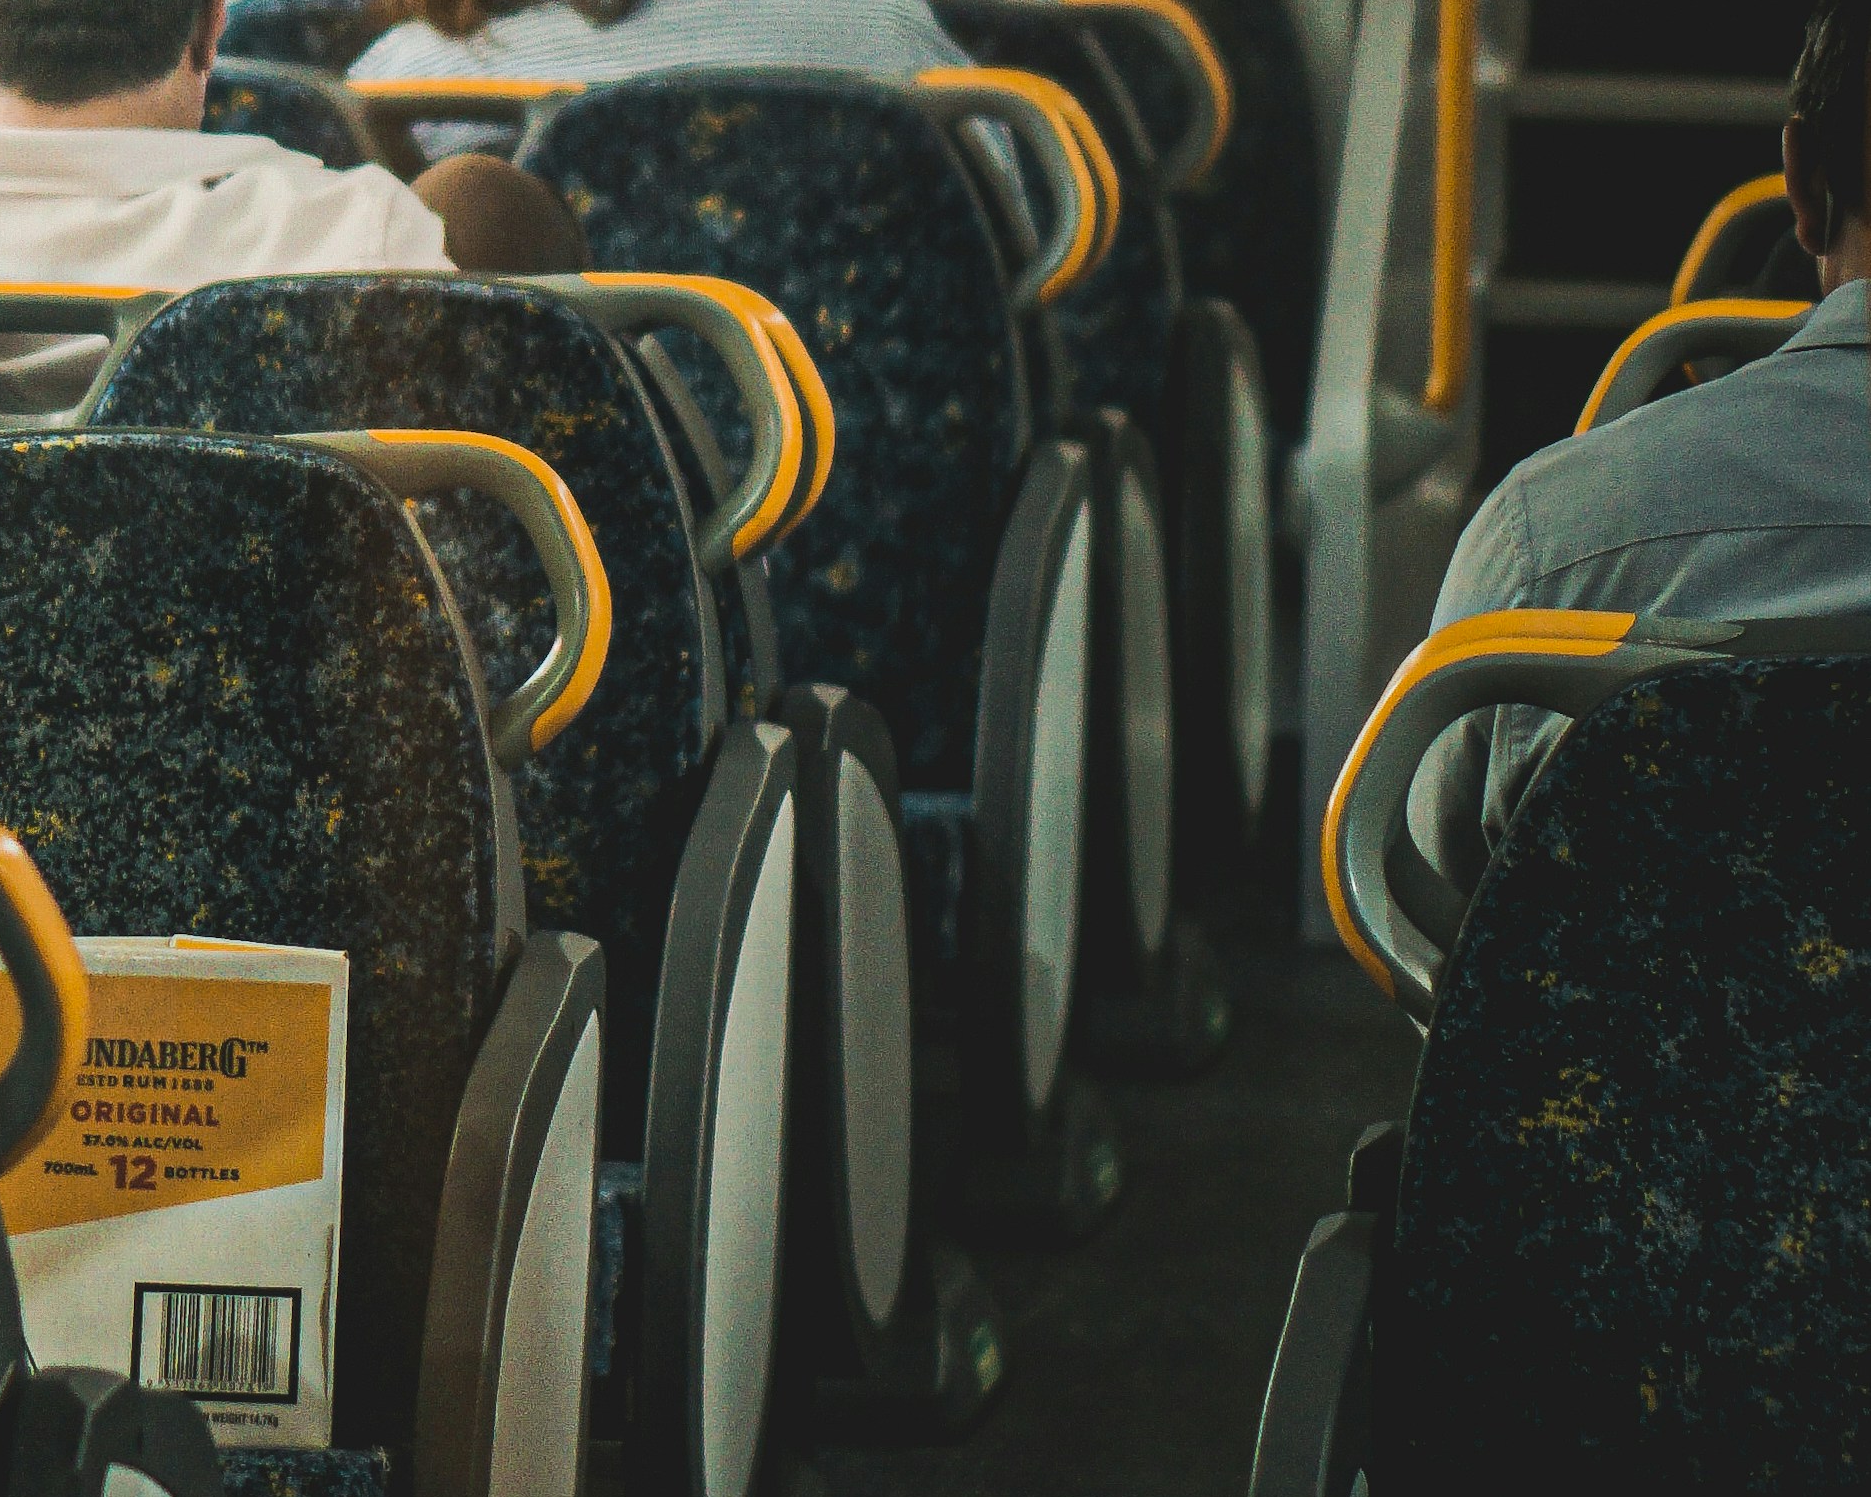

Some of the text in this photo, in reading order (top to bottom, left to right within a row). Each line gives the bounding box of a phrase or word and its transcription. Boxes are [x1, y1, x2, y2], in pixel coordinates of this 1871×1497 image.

[77, 1074, 119, 1088] ESTD
[122, 1075, 168, 1090] RUM
[70, 1099, 220, 1127] ORIGINAL
[132, 1135, 204, 1151] ALC/VOL
[109, 1153, 158, 1191] 12
[164, 1165, 240, 1181] BOTTLES
[212, 1411, 247, 1424] WEIGHT
